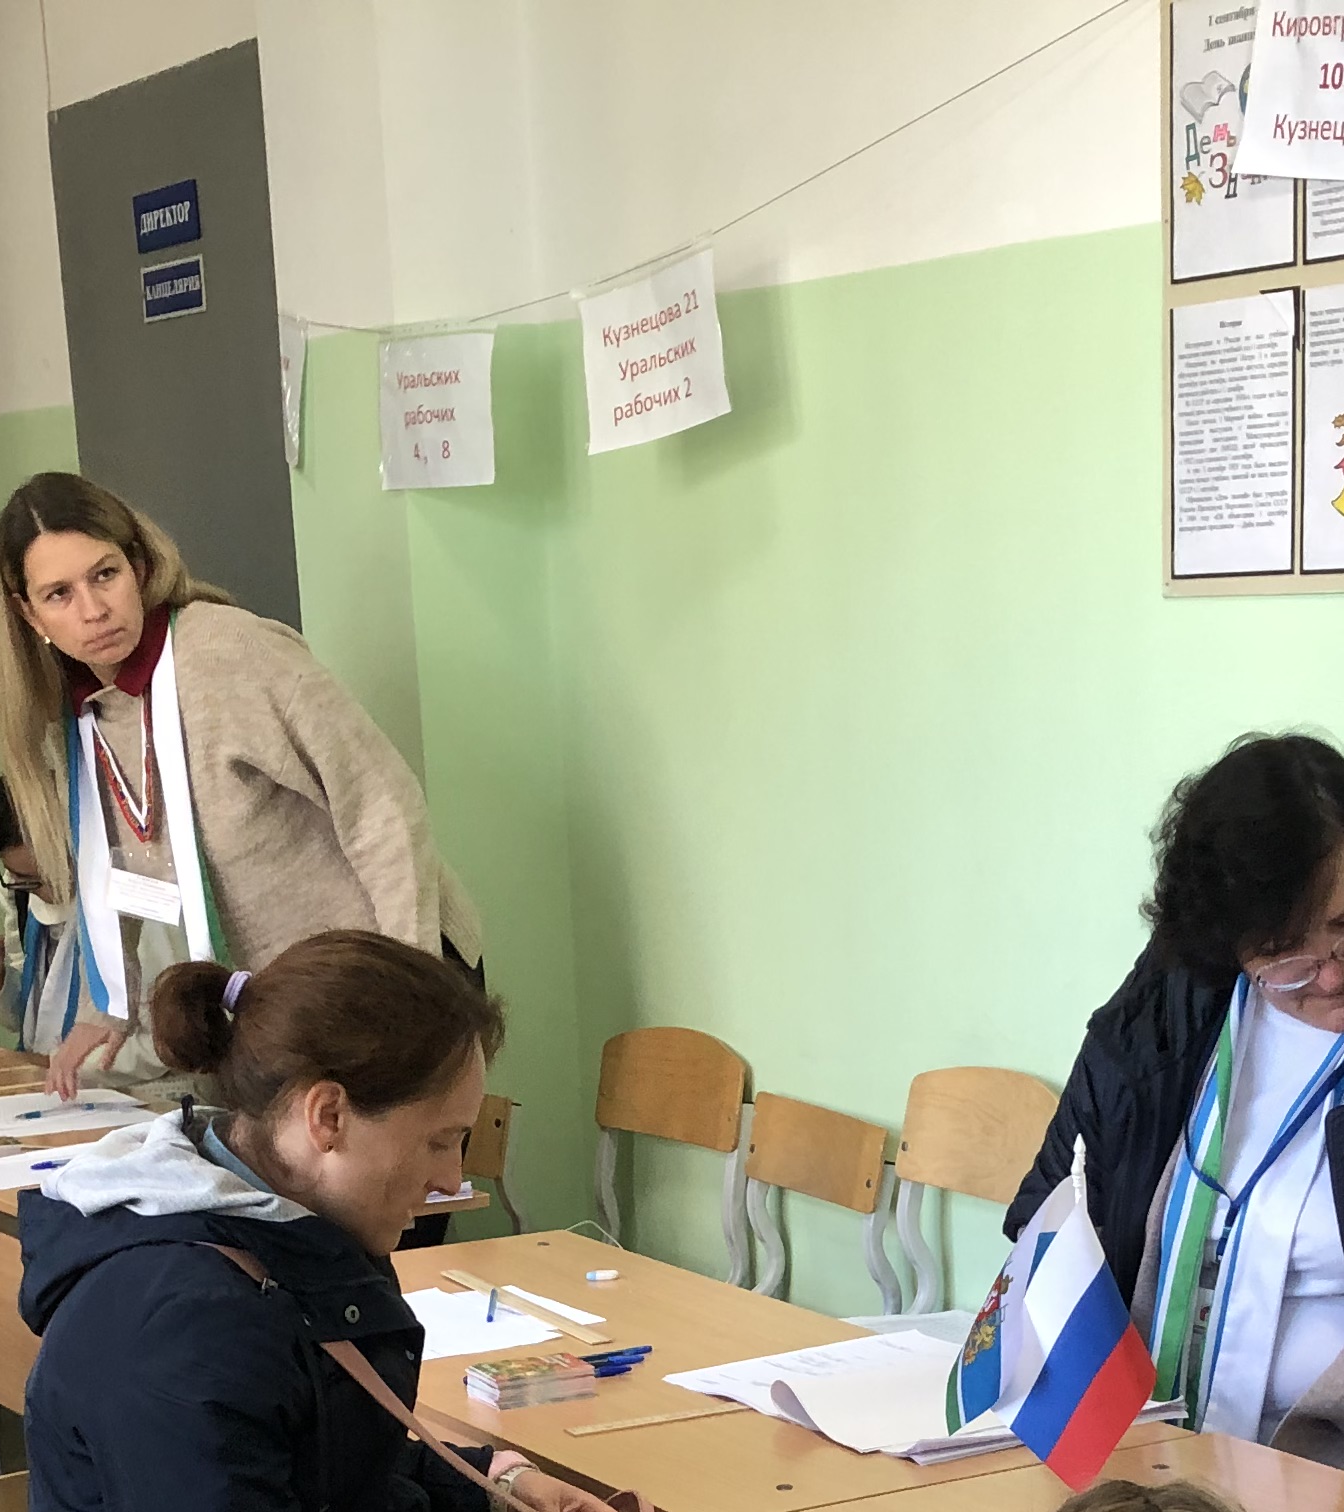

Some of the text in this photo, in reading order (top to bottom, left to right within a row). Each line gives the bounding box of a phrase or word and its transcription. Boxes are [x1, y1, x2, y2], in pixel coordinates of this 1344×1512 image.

[1319, 62, 1344, 90] 10
[140, 200, 191, 236] ДИРЕКТОР
[146, 274, 201, 301] КАНЦЕЛЯРИЯ
[602, 289, 699, 348] Кузнецова 21
[618, 336, 697, 381] Уральских
[396, 368, 461, 392] Уральских
[613, 376, 692, 427] рабочих 2
[404, 404, 456, 429] рабочих
[413, 440, 451, 464] 4, 8
